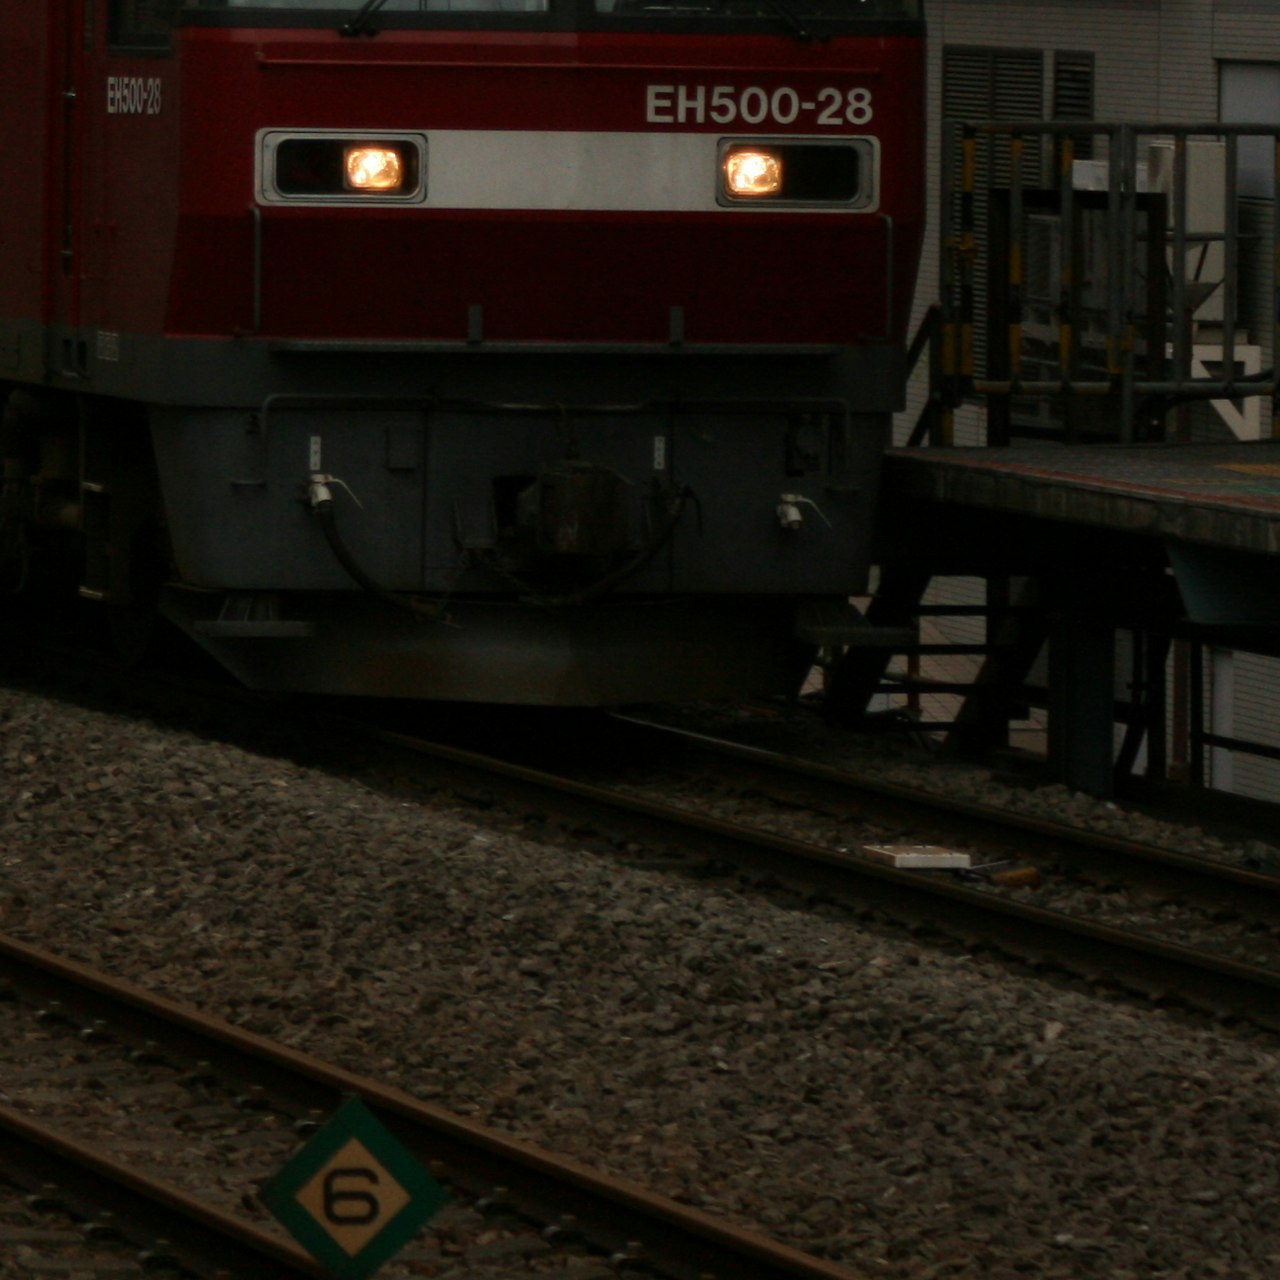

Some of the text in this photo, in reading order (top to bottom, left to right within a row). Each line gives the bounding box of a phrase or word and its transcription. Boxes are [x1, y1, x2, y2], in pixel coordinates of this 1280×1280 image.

[107, 76, 161, 114] EH500-28
[646, 84, 874, 125] EH500-28
[324, 1168, 379, 1225] 6
